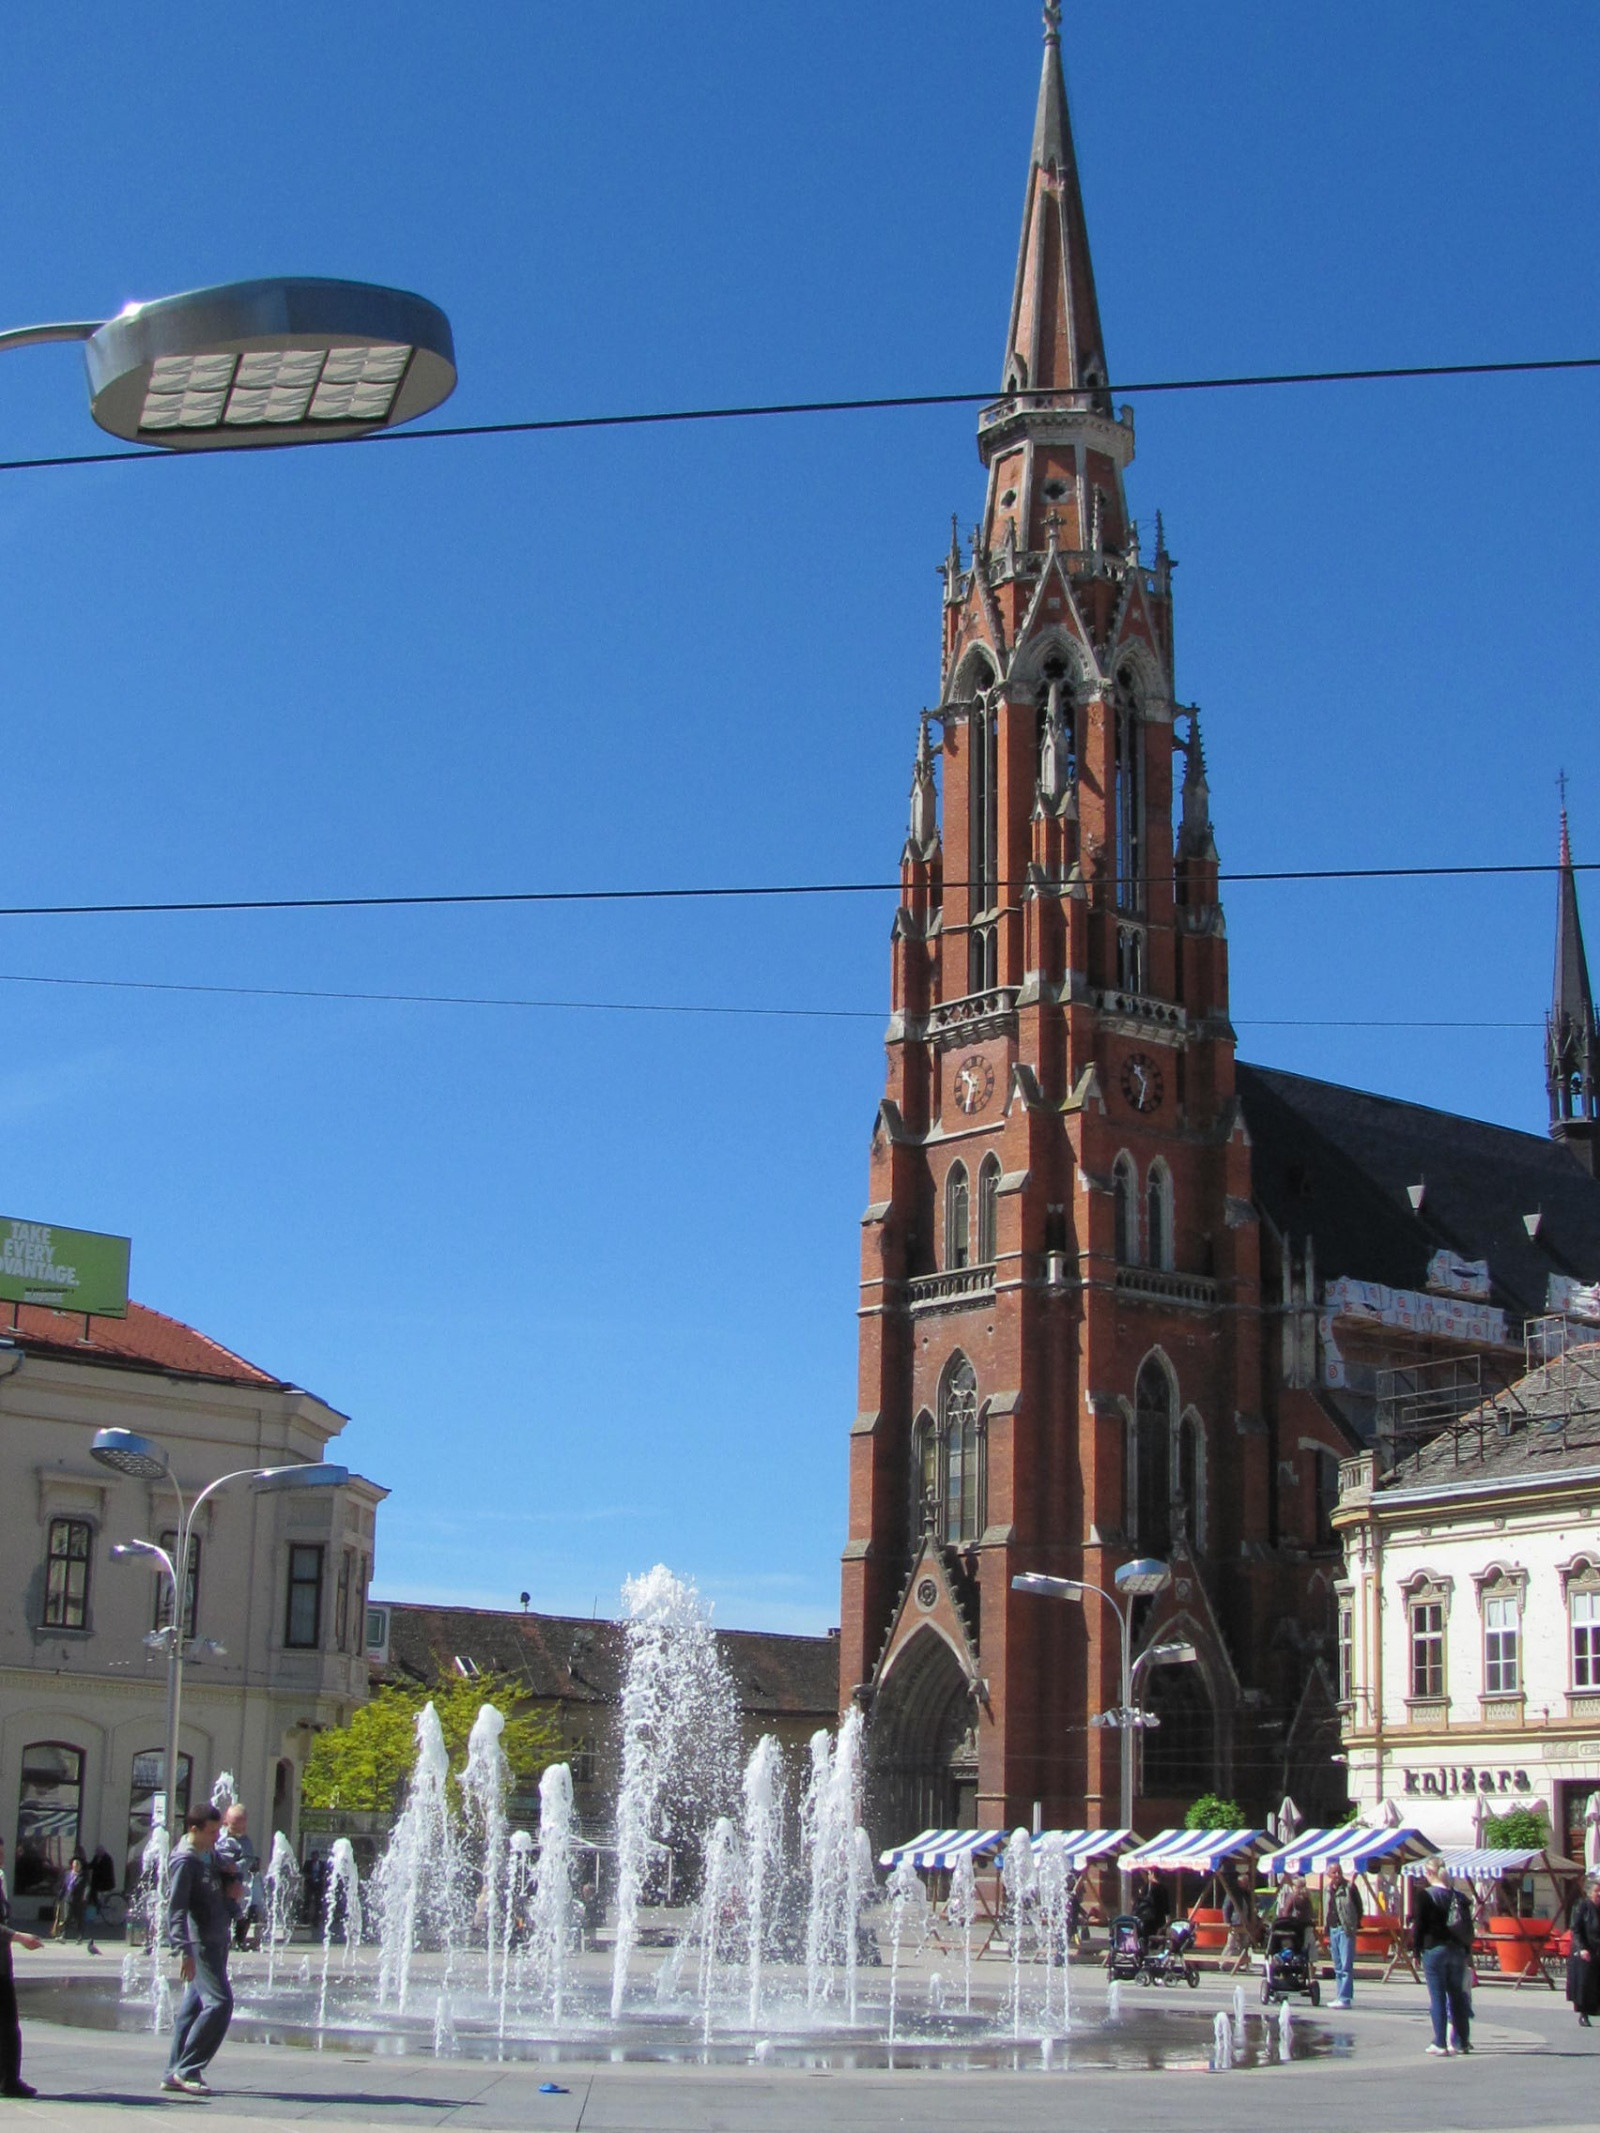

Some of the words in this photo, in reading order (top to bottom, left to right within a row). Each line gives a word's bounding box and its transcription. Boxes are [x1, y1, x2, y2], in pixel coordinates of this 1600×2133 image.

[11, 1221, 52, 1244] TAKE
[3, 1238, 57, 1263] EVERY
[1402, 1766, 1532, 1796] knjižara
